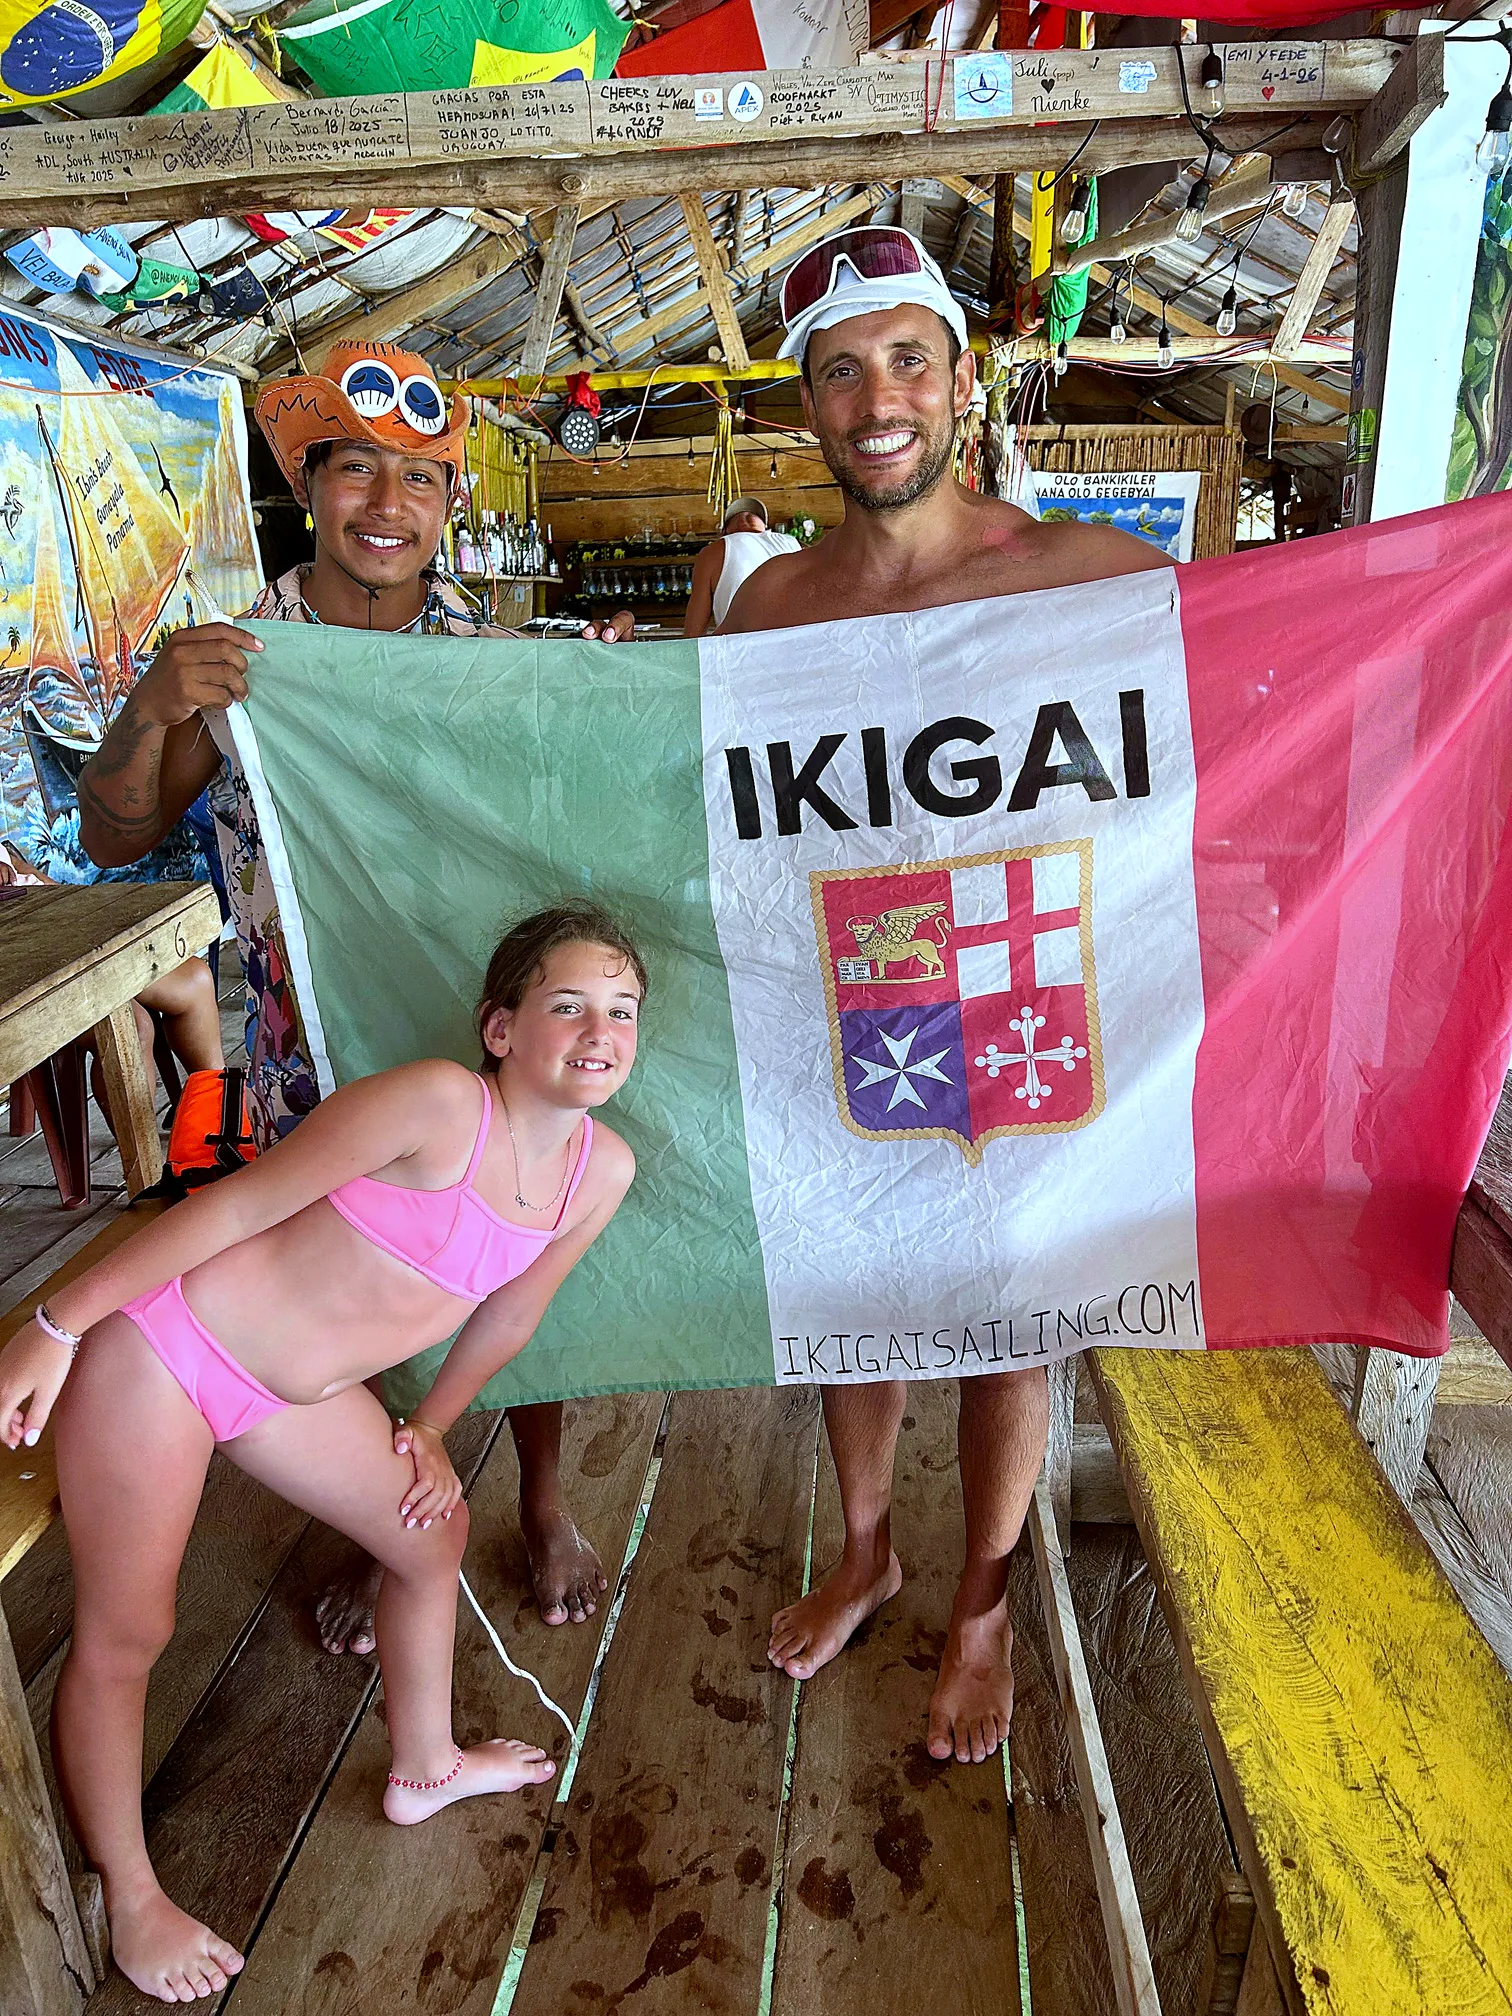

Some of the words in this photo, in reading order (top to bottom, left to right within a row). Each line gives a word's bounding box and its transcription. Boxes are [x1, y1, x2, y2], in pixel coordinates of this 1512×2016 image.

[1227, 49, 1252, 61] EMI
[1256, 49, 1268, 63] Y
[1269, 49, 1307, 61] FEDE
[1015, 57, 1049, 78] Juli
[488, 90, 510, 101] POR
[521, 89, 546, 100] ESTA
[656, 87, 683, 99] LUV
[770, 89, 837, 104] ROOFMARKT
[786, 103, 822, 113] 2025
[1031, 89, 1091, 113] Nienke
[734, 105, 760, 114] APEX
[290, 121, 319, 136] Julio
[66, 172, 86, 183] AUG
[90, 169, 114, 181] 2025
[90, 346, 155, 398] EDGE
[95, 448, 114, 478] Beach
[1054, 475, 1079, 486] OLO
[1083, 474, 1157, 485] BANKIKILER
[1068, 487, 1091, 499] OLO
[1096, 487, 1155, 499] GEGEBYAI
[96, 482, 124, 525] Gunayala
[724, 690, 1151, 840] IKIGAI
[175, 921, 187, 959] 6
[778, 1279, 1201, 1376] IKIGAISAILING.COM
